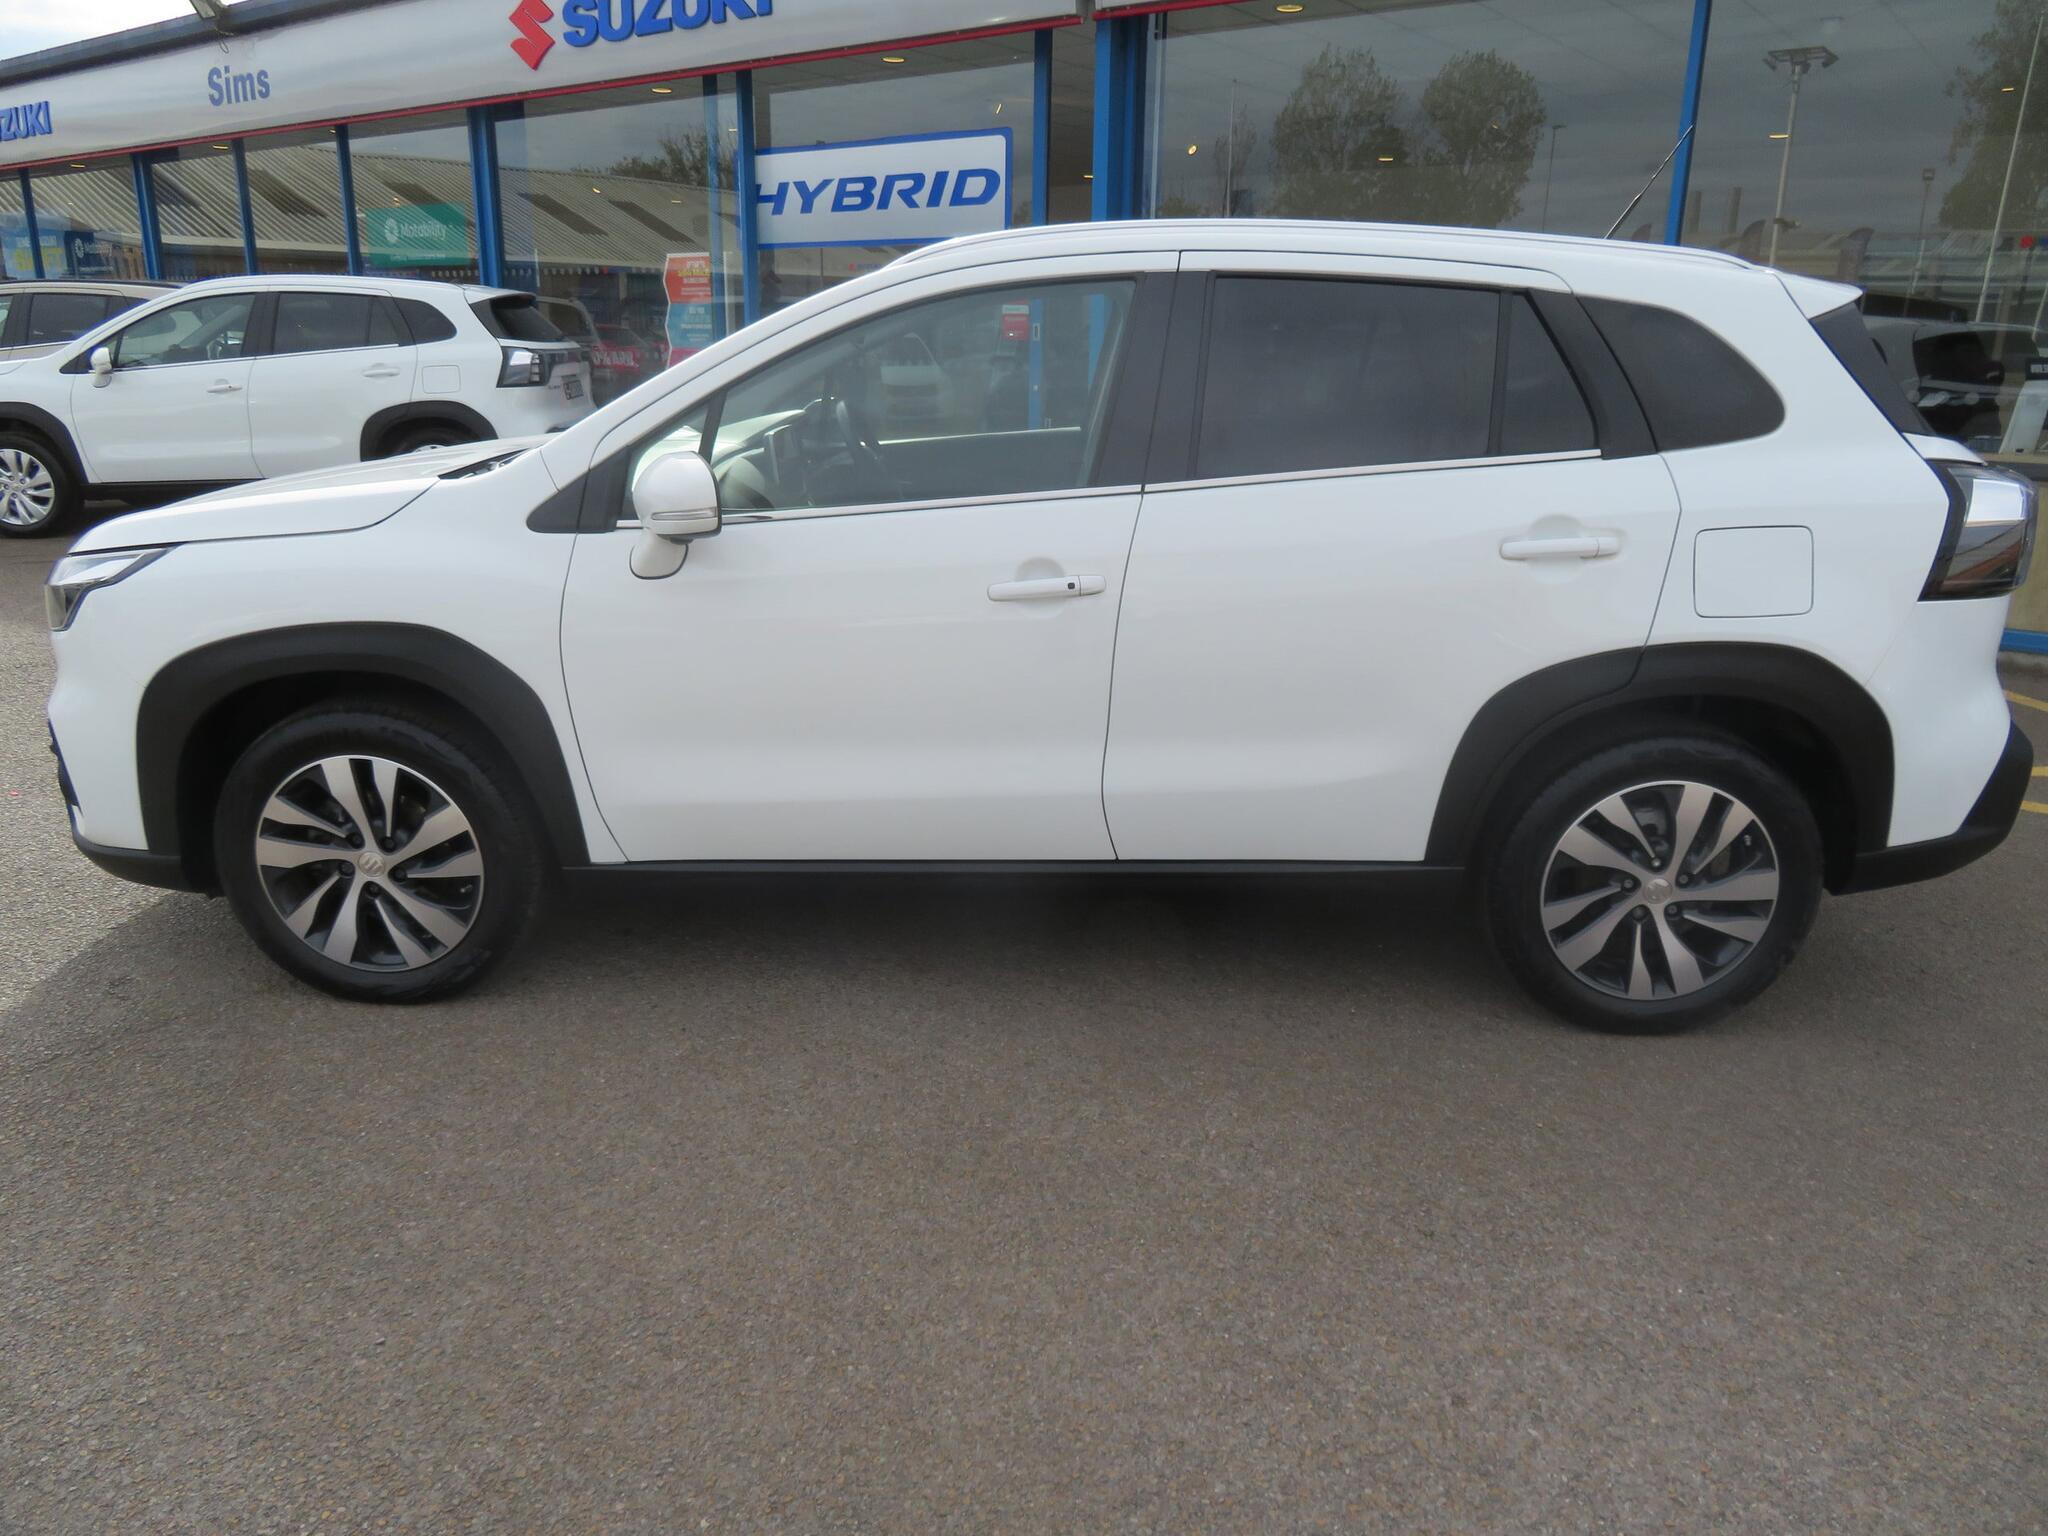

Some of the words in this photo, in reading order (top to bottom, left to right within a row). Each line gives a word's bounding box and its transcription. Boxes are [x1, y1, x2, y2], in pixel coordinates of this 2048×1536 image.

[207, 65, 271, 107] Sims
[0, 100, 52, 141] ZUKI
[756, 168, 1001, 216] HYBRID
